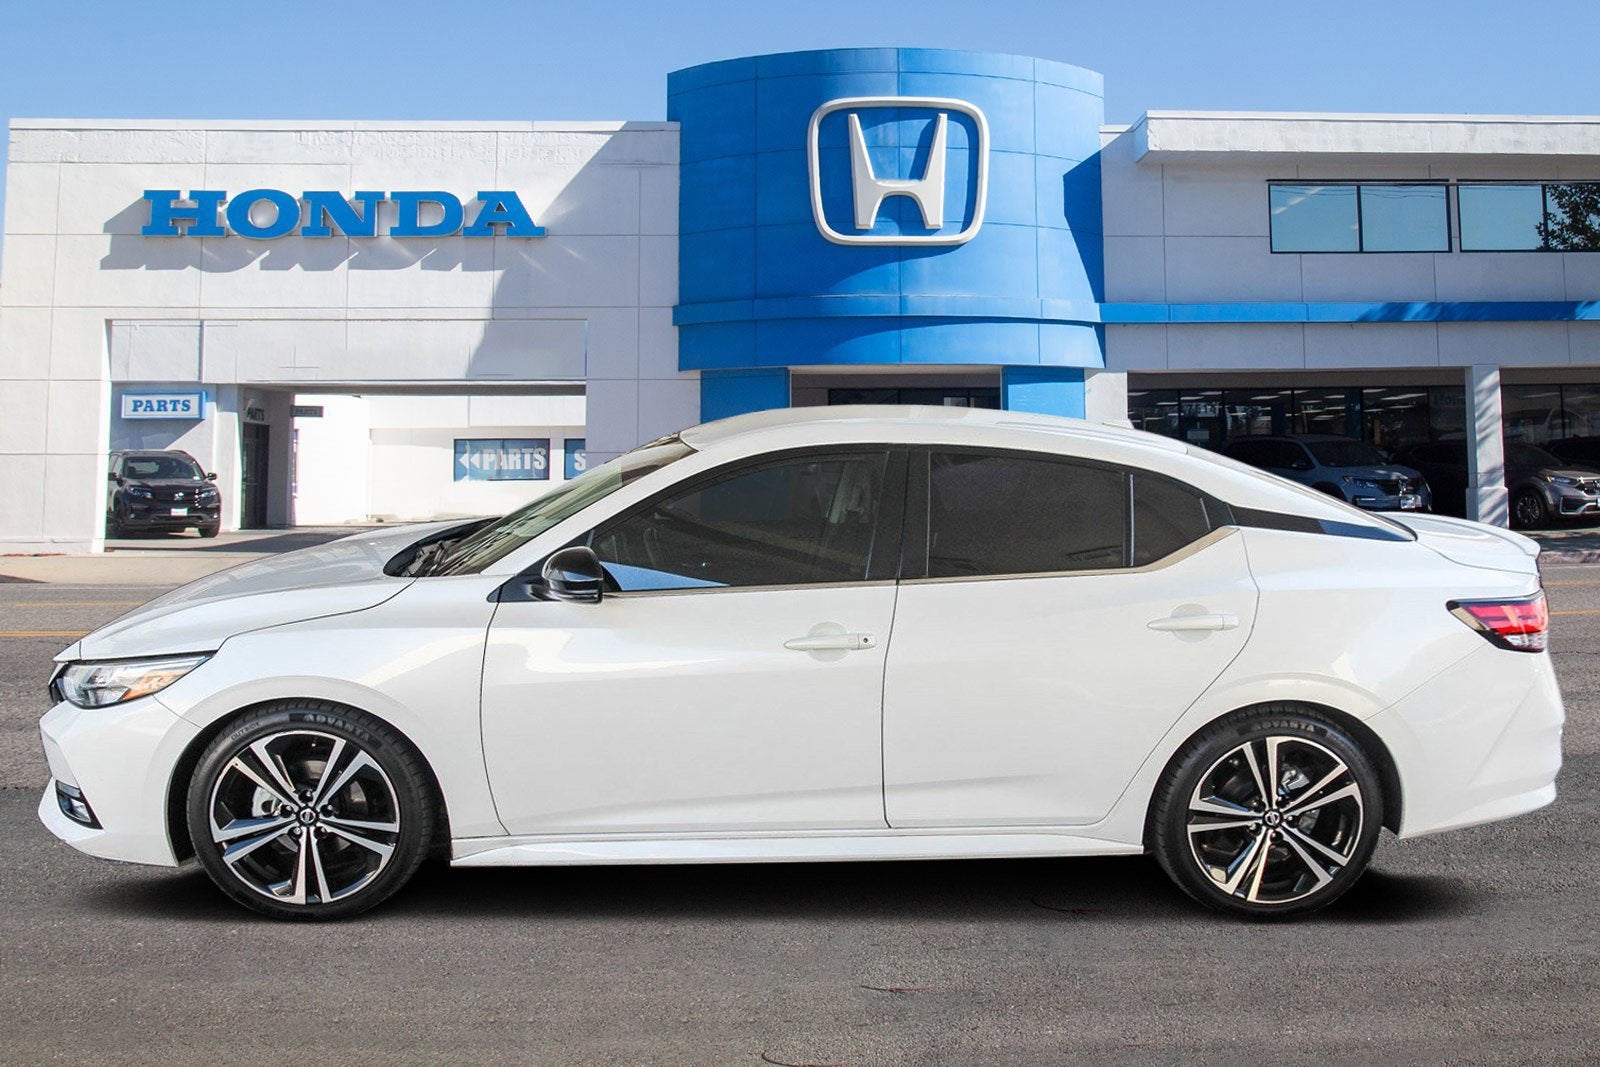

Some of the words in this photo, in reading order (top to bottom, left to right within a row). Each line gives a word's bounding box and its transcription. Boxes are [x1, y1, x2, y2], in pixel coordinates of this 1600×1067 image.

[141, 188, 547, 240] HONDA
[131, 399, 192, 412] PARTS
[482, 447, 547, 470] PARTS
[303, 713, 370, 742] ADVANTA
